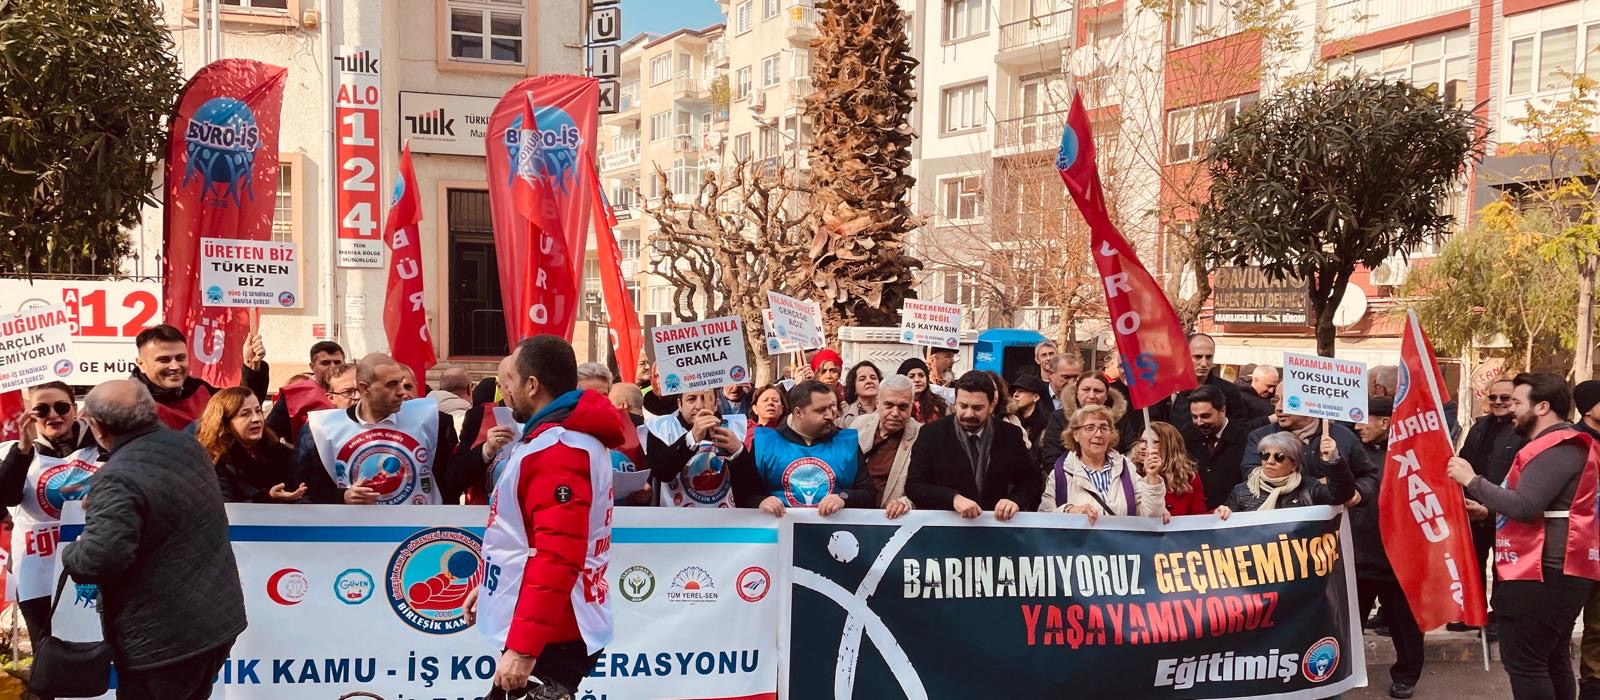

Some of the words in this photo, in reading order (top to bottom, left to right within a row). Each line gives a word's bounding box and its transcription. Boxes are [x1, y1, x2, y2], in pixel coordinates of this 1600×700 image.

[336, 84, 379, 105] ALO
[186, 120, 259, 150] BÜRO-İŞ
[205, 241, 264, 260] ÜRETEN
[269, 245, 294, 261] BİZ
[211, 261, 289, 274] TÜKENEN
[238, 276, 264, 287] BİZ
[0, 310, 67, 337] UĞUMA
[655, 326, 699, 344] SARAYA
[700, 319, 738, 336] TONLA
[917, 322, 957, 333] KAYNASIN
[667, 336, 731, 355] EMEKÇİYE
[676, 351, 728, 367] GRAMLA
[1288, 356, 1333, 371] RAKAMLAR
[1335, 363, 1361, 375] YALAN
[1290, 370, 1361, 388] YOKSULLUK
[1301, 384, 1349, 399] GERÇEK
[903, 553, 1146, 599] BARINAMIYORUZ
[1153, 530, 1340, 595] GEÇİNEMİYOR
[398, 602, 441, 631] BİRLEŞİK
[1020, 592, 1280, 650] YAŞAYAMIYORUZ
[213, 658, 260, 684] İK
[273, 657, 376, 685] KAMU
[408, 650, 440, 687] İŞ
[1153, 648, 1300, 690] Eğitimiş
